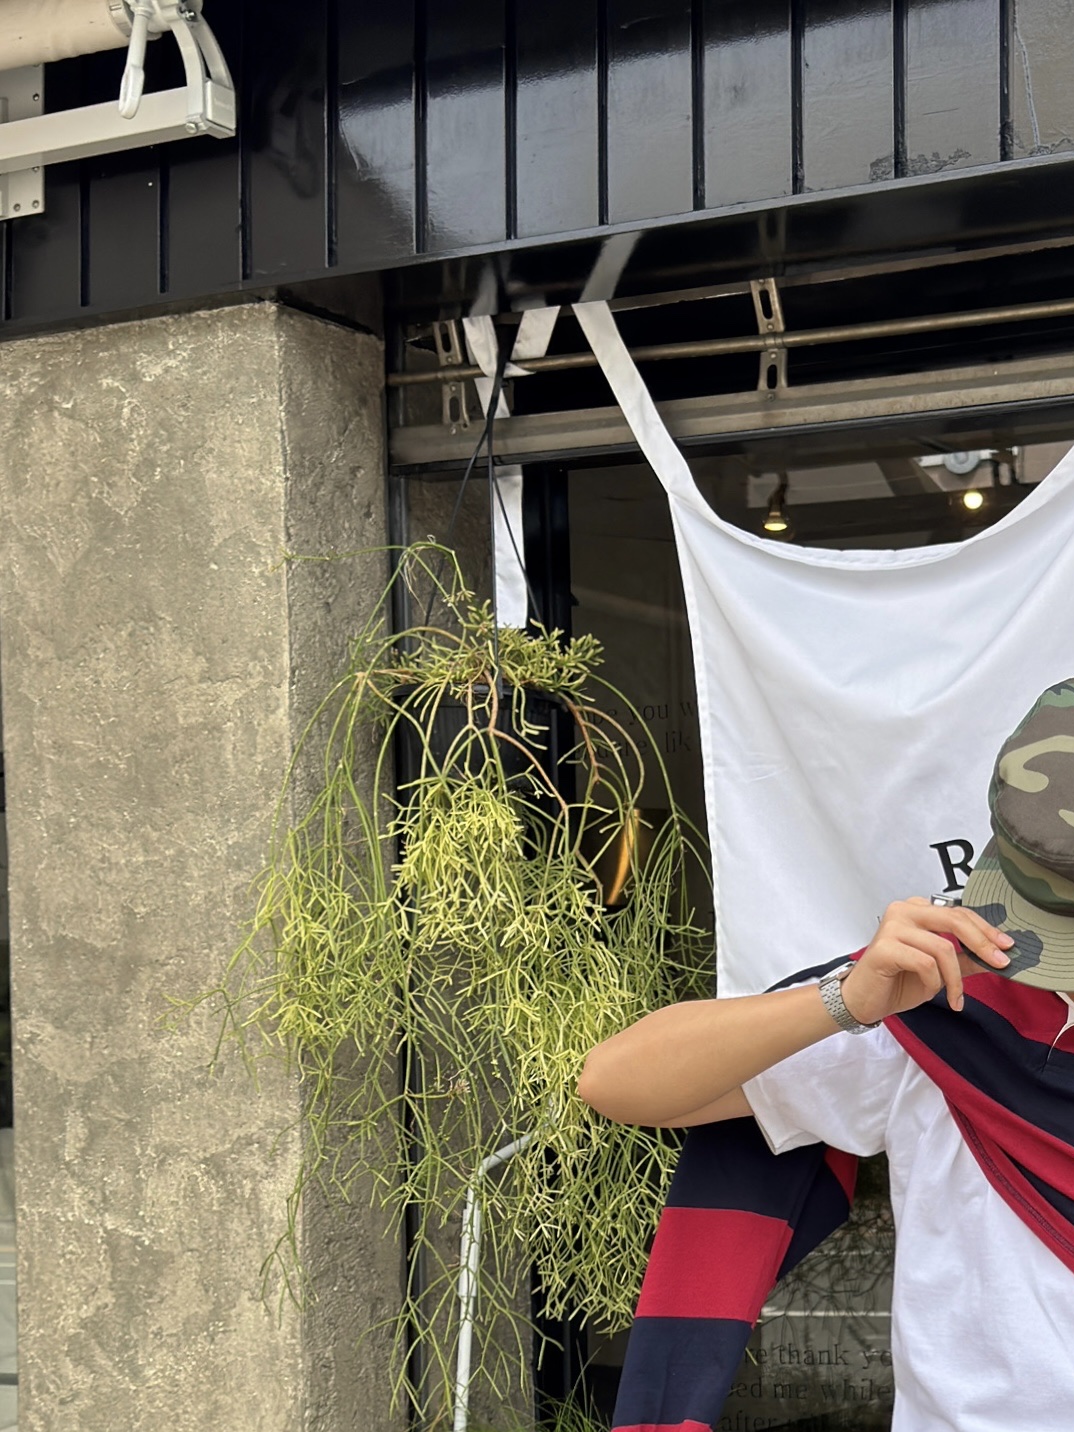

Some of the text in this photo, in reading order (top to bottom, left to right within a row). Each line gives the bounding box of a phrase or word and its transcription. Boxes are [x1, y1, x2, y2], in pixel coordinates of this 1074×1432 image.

[778, 1342, 849, 1366] thank
[773, 1382, 808, 1400] me
[821, 1379, 892, 1401] while
